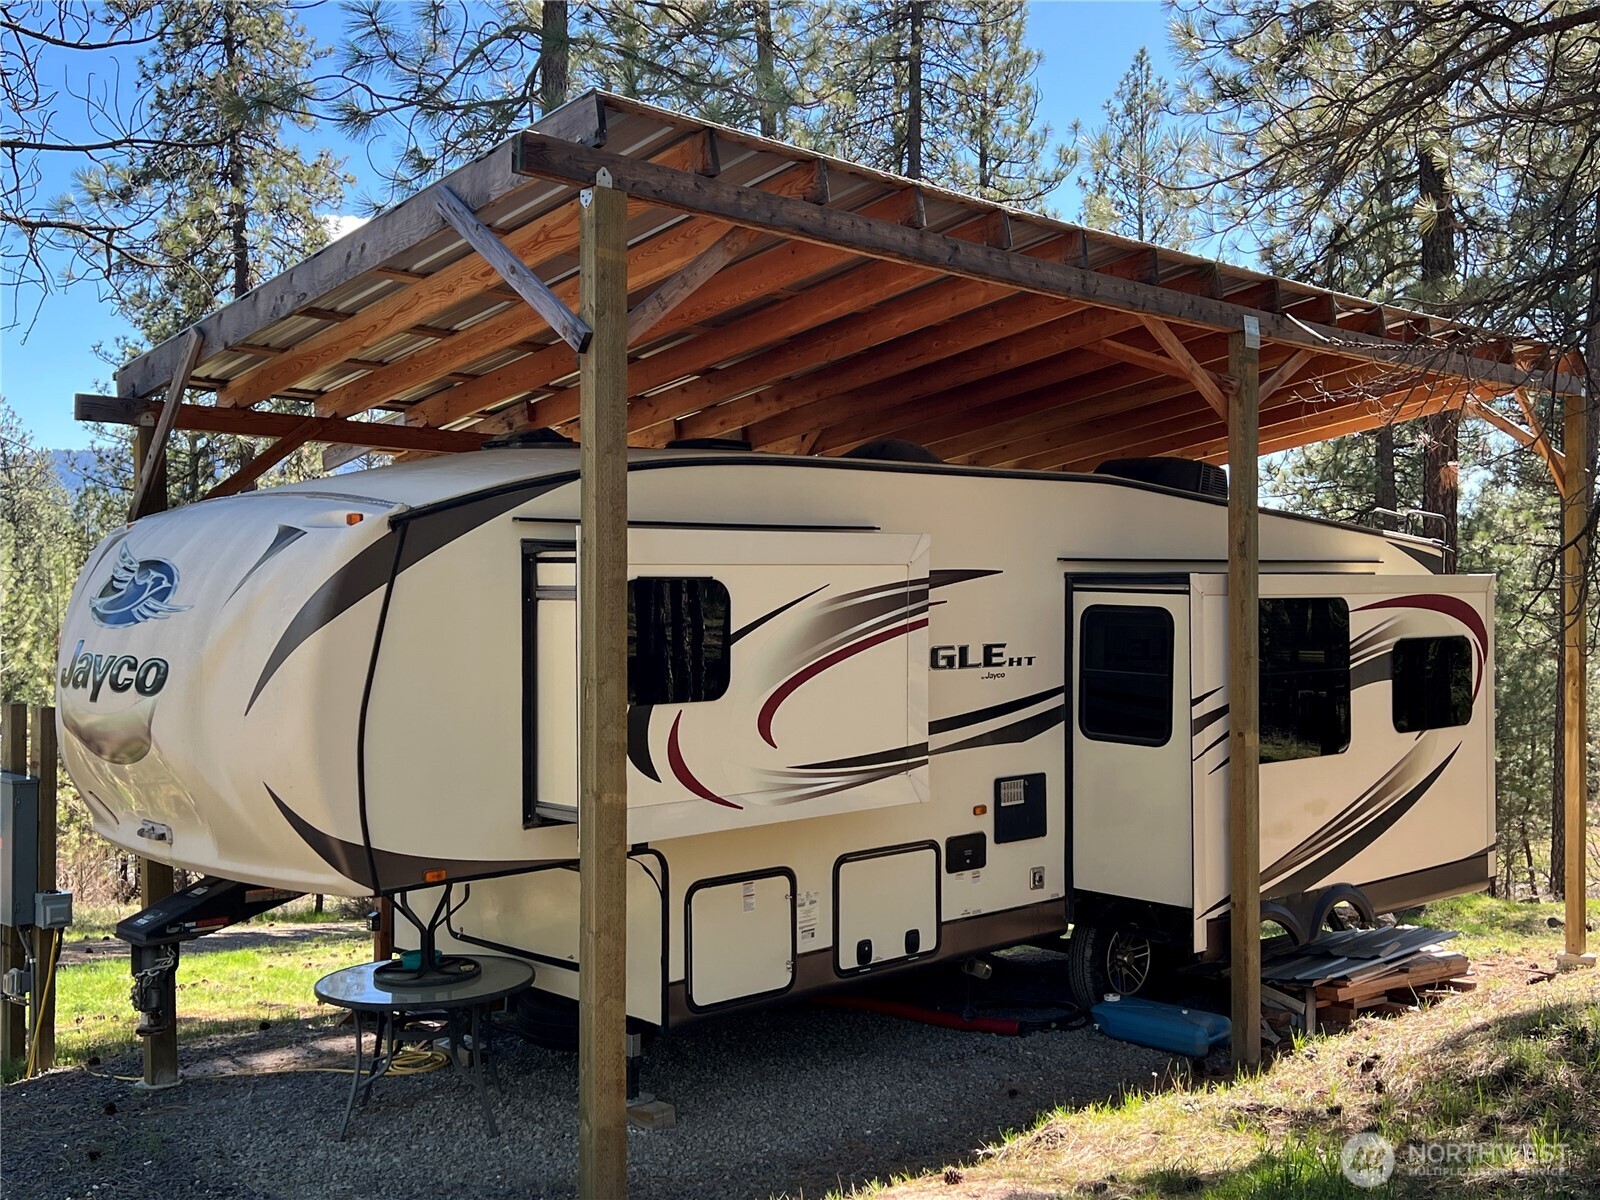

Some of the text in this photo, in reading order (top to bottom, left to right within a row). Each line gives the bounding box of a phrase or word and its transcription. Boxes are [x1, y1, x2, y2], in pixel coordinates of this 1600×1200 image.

[61, 639, 169, 703] Jayco
[929, 642, 1037, 671] GLE HT
[985, 671, 1006, 680] Jayco
